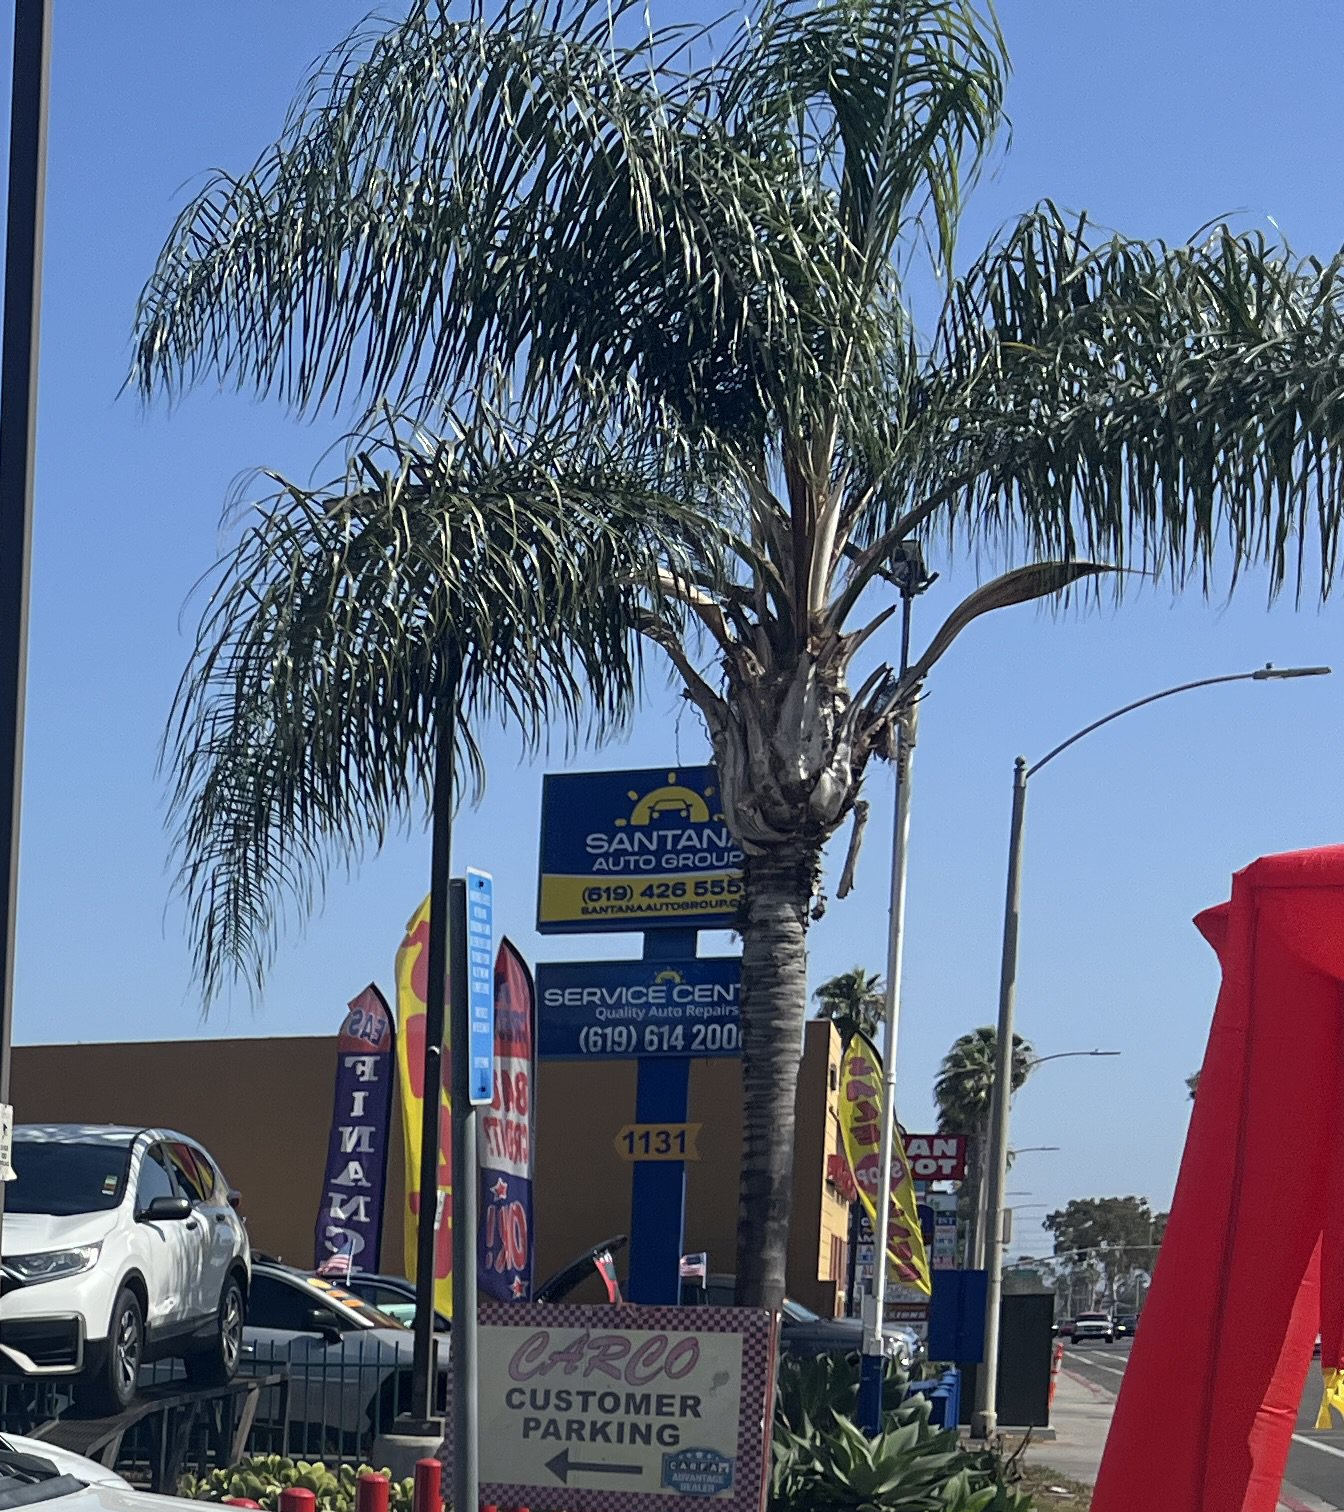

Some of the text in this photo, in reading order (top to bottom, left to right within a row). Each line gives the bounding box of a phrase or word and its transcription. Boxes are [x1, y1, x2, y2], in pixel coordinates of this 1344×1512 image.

[585, 828, 733, 854] SANTAN
[592, 851, 744, 872] AUTO GROUP
[582, 879, 743, 904] (619) 426 555
[581, 899, 742, 915] SANTANAAUTOGROUP.C
[544, 986, 666, 1006] SERVICE
[595, 1004, 739, 1021] Quality Auto Repairs
[579, 1023, 742, 1053] (619) 614 200
[622, 1128, 688, 1155] 1131
[906, 1138, 959, 1157] AN
[913, 1158, 958, 1176] OT
[508, 1330, 701, 1386] CARCO
[505, 1387, 702, 1418] CUSTOMER
[522, 1417, 681, 1447] PARKING
